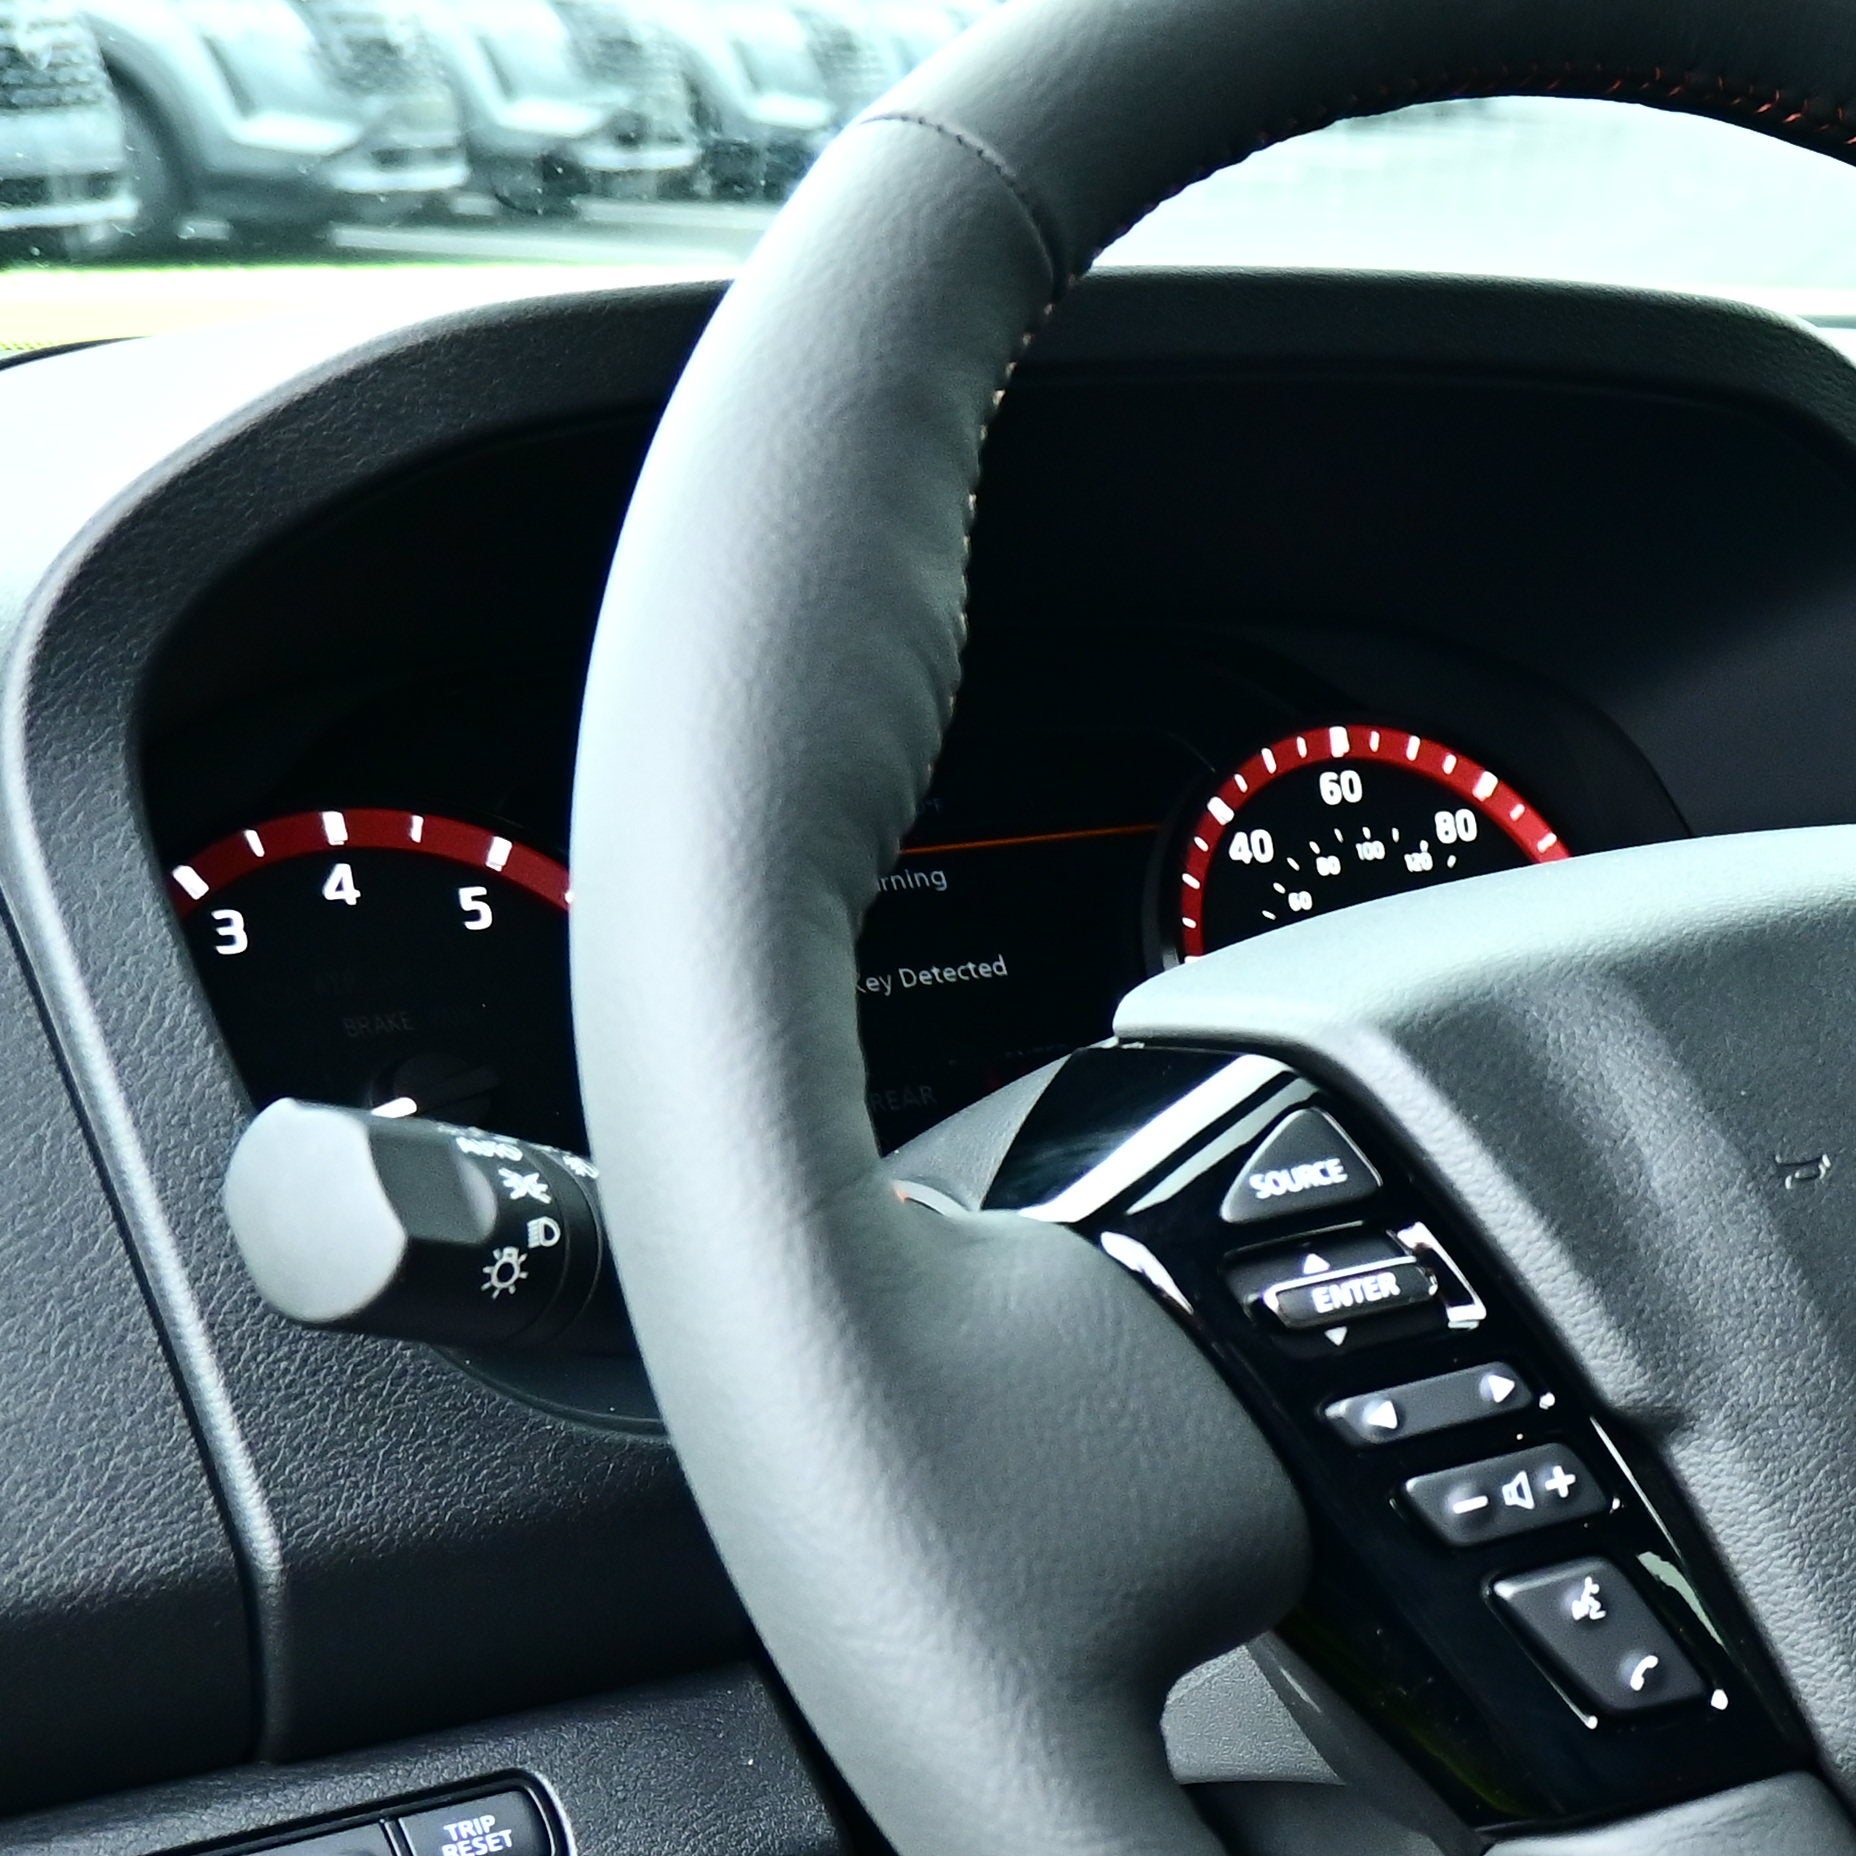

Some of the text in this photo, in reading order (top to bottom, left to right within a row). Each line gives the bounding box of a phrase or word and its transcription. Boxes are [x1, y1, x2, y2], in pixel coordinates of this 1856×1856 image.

[1319, 770, 1363, 806] 60
[1434, 808, 1478, 844] 80
[1228, 829, 1275, 865] 40
[1355, 840, 1386, 861] 100
[323, 864, 361, 906] 4
[877, 868, 948, 893] rning
[460, 887, 493, 930] 5
[215, 909, 249, 955] 3
[899, 954, 1009, 989] Detected
[1248, 1156, 1349, 1200] SOURCE
[1311, 1271, 1401, 1314] ENTER
[442, 1815, 498, 1844] TRIP
